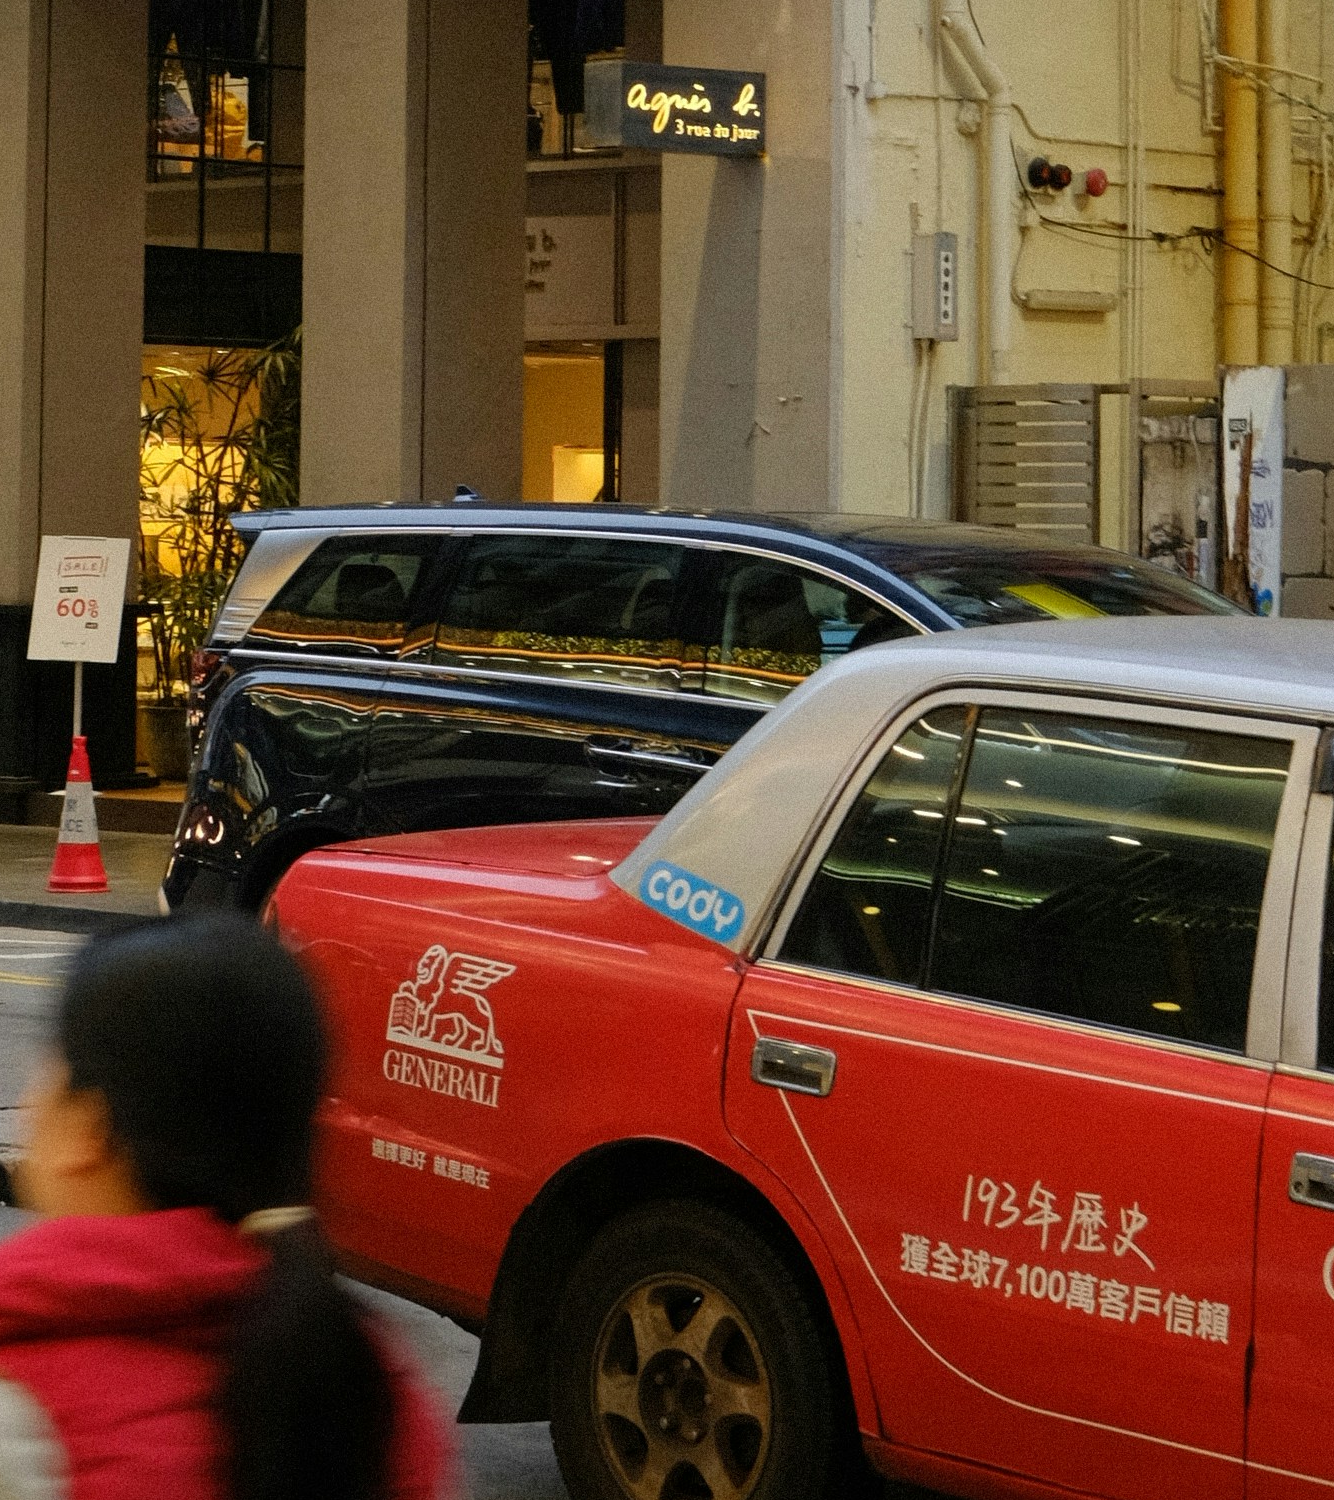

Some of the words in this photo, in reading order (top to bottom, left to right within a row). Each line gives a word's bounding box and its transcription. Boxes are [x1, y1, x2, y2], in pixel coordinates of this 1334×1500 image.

[627, 83, 712, 134] agnès
[731, 83, 761, 117] b.
[674, 118, 685, 135] 3
[686, 124, 711, 138] rue
[56, 597, 100, 619] 60%
[382, 1048, 502, 1108] GENERALI
[961, 1173, 1157, 1272] 193年歷史
